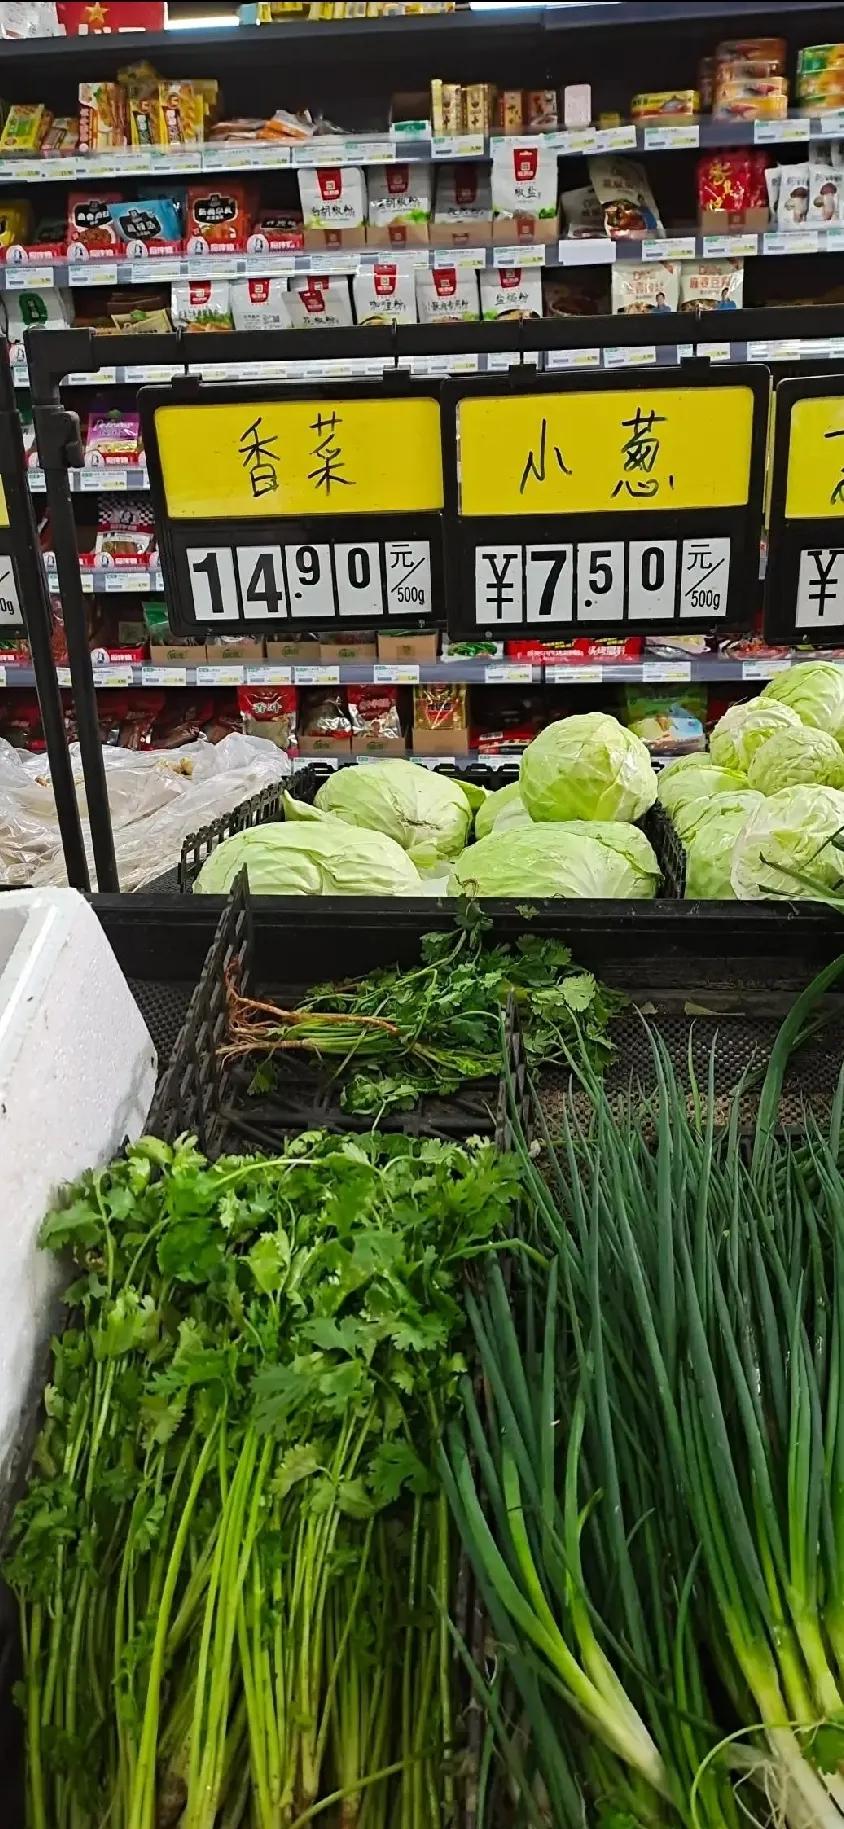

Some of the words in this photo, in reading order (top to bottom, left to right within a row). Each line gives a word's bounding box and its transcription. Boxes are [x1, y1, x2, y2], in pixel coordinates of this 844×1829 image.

[238, 410, 357, 497] 香菜
[519, 407, 675, 498] 小葱
[192, 545, 371, 614] 14.90
